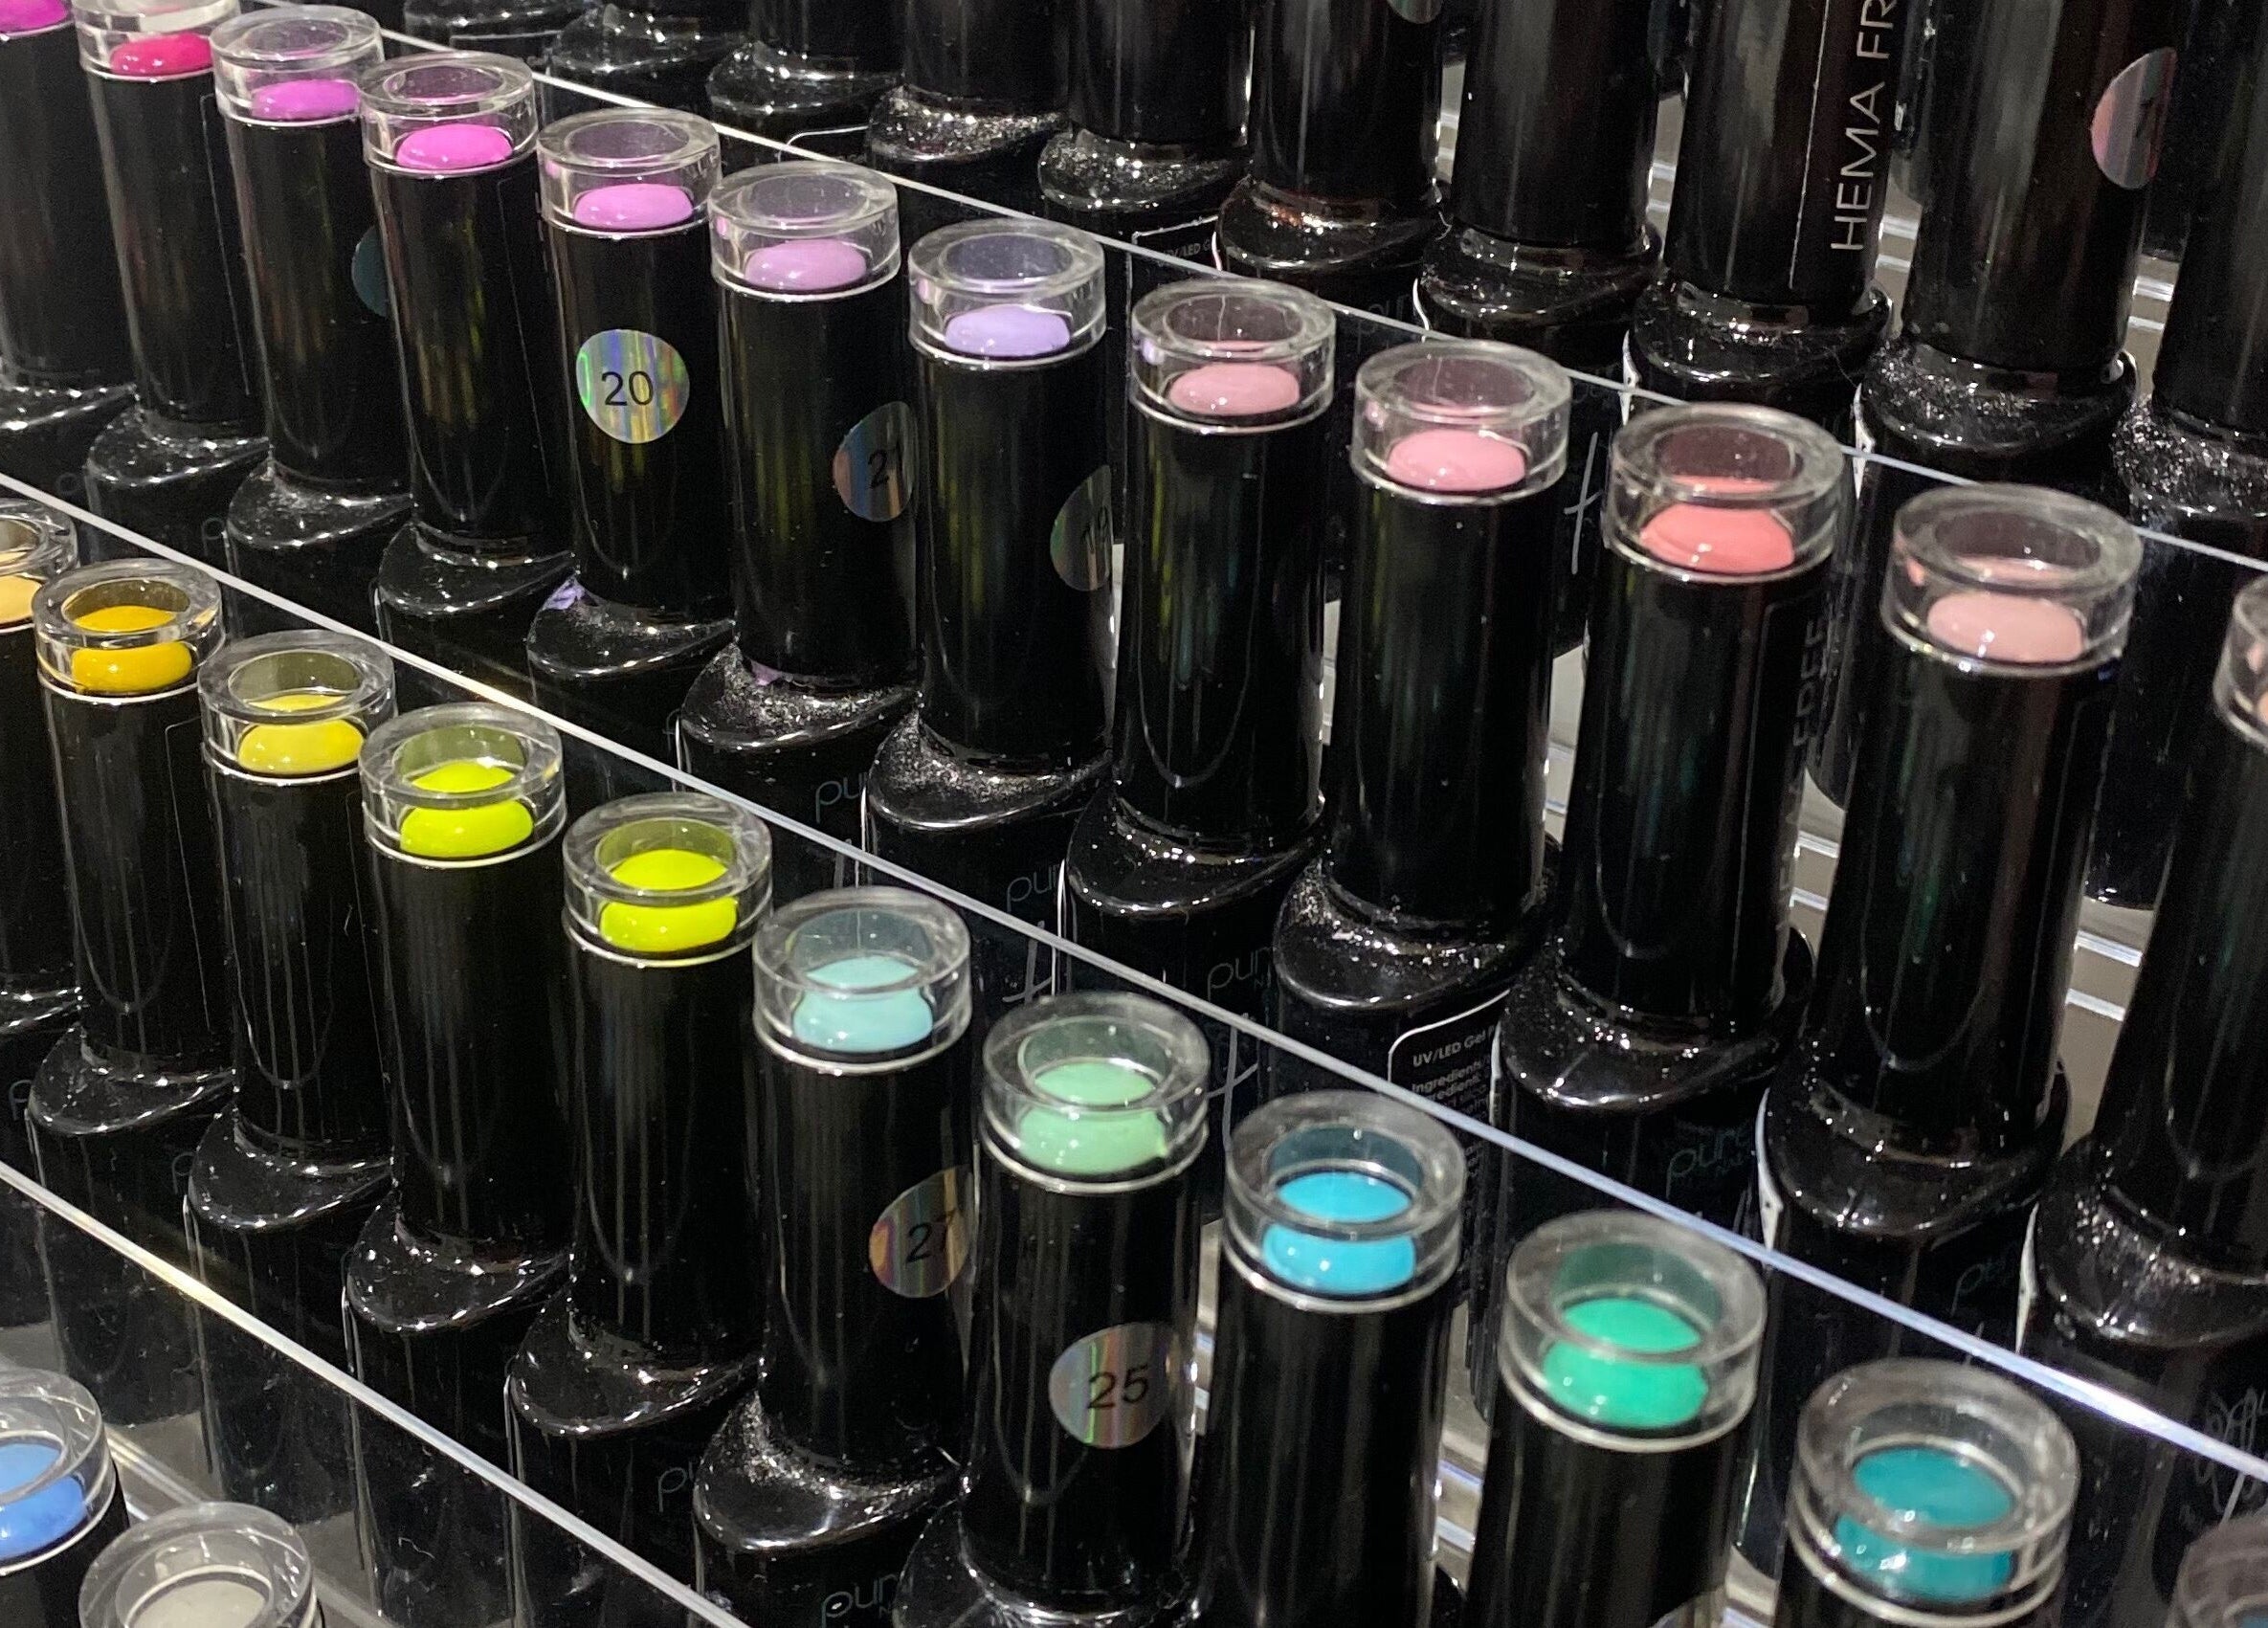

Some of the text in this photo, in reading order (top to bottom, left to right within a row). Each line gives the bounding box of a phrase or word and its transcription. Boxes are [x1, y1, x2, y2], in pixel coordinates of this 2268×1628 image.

[1831, 80, 1886, 251] HEMA
[601, 369, 655, 407] 20
[1412, 1041, 1463, 1069] UV/LED
[907, 1207, 958, 1262] 27
[1088, 1363, 1148, 1410] 25
